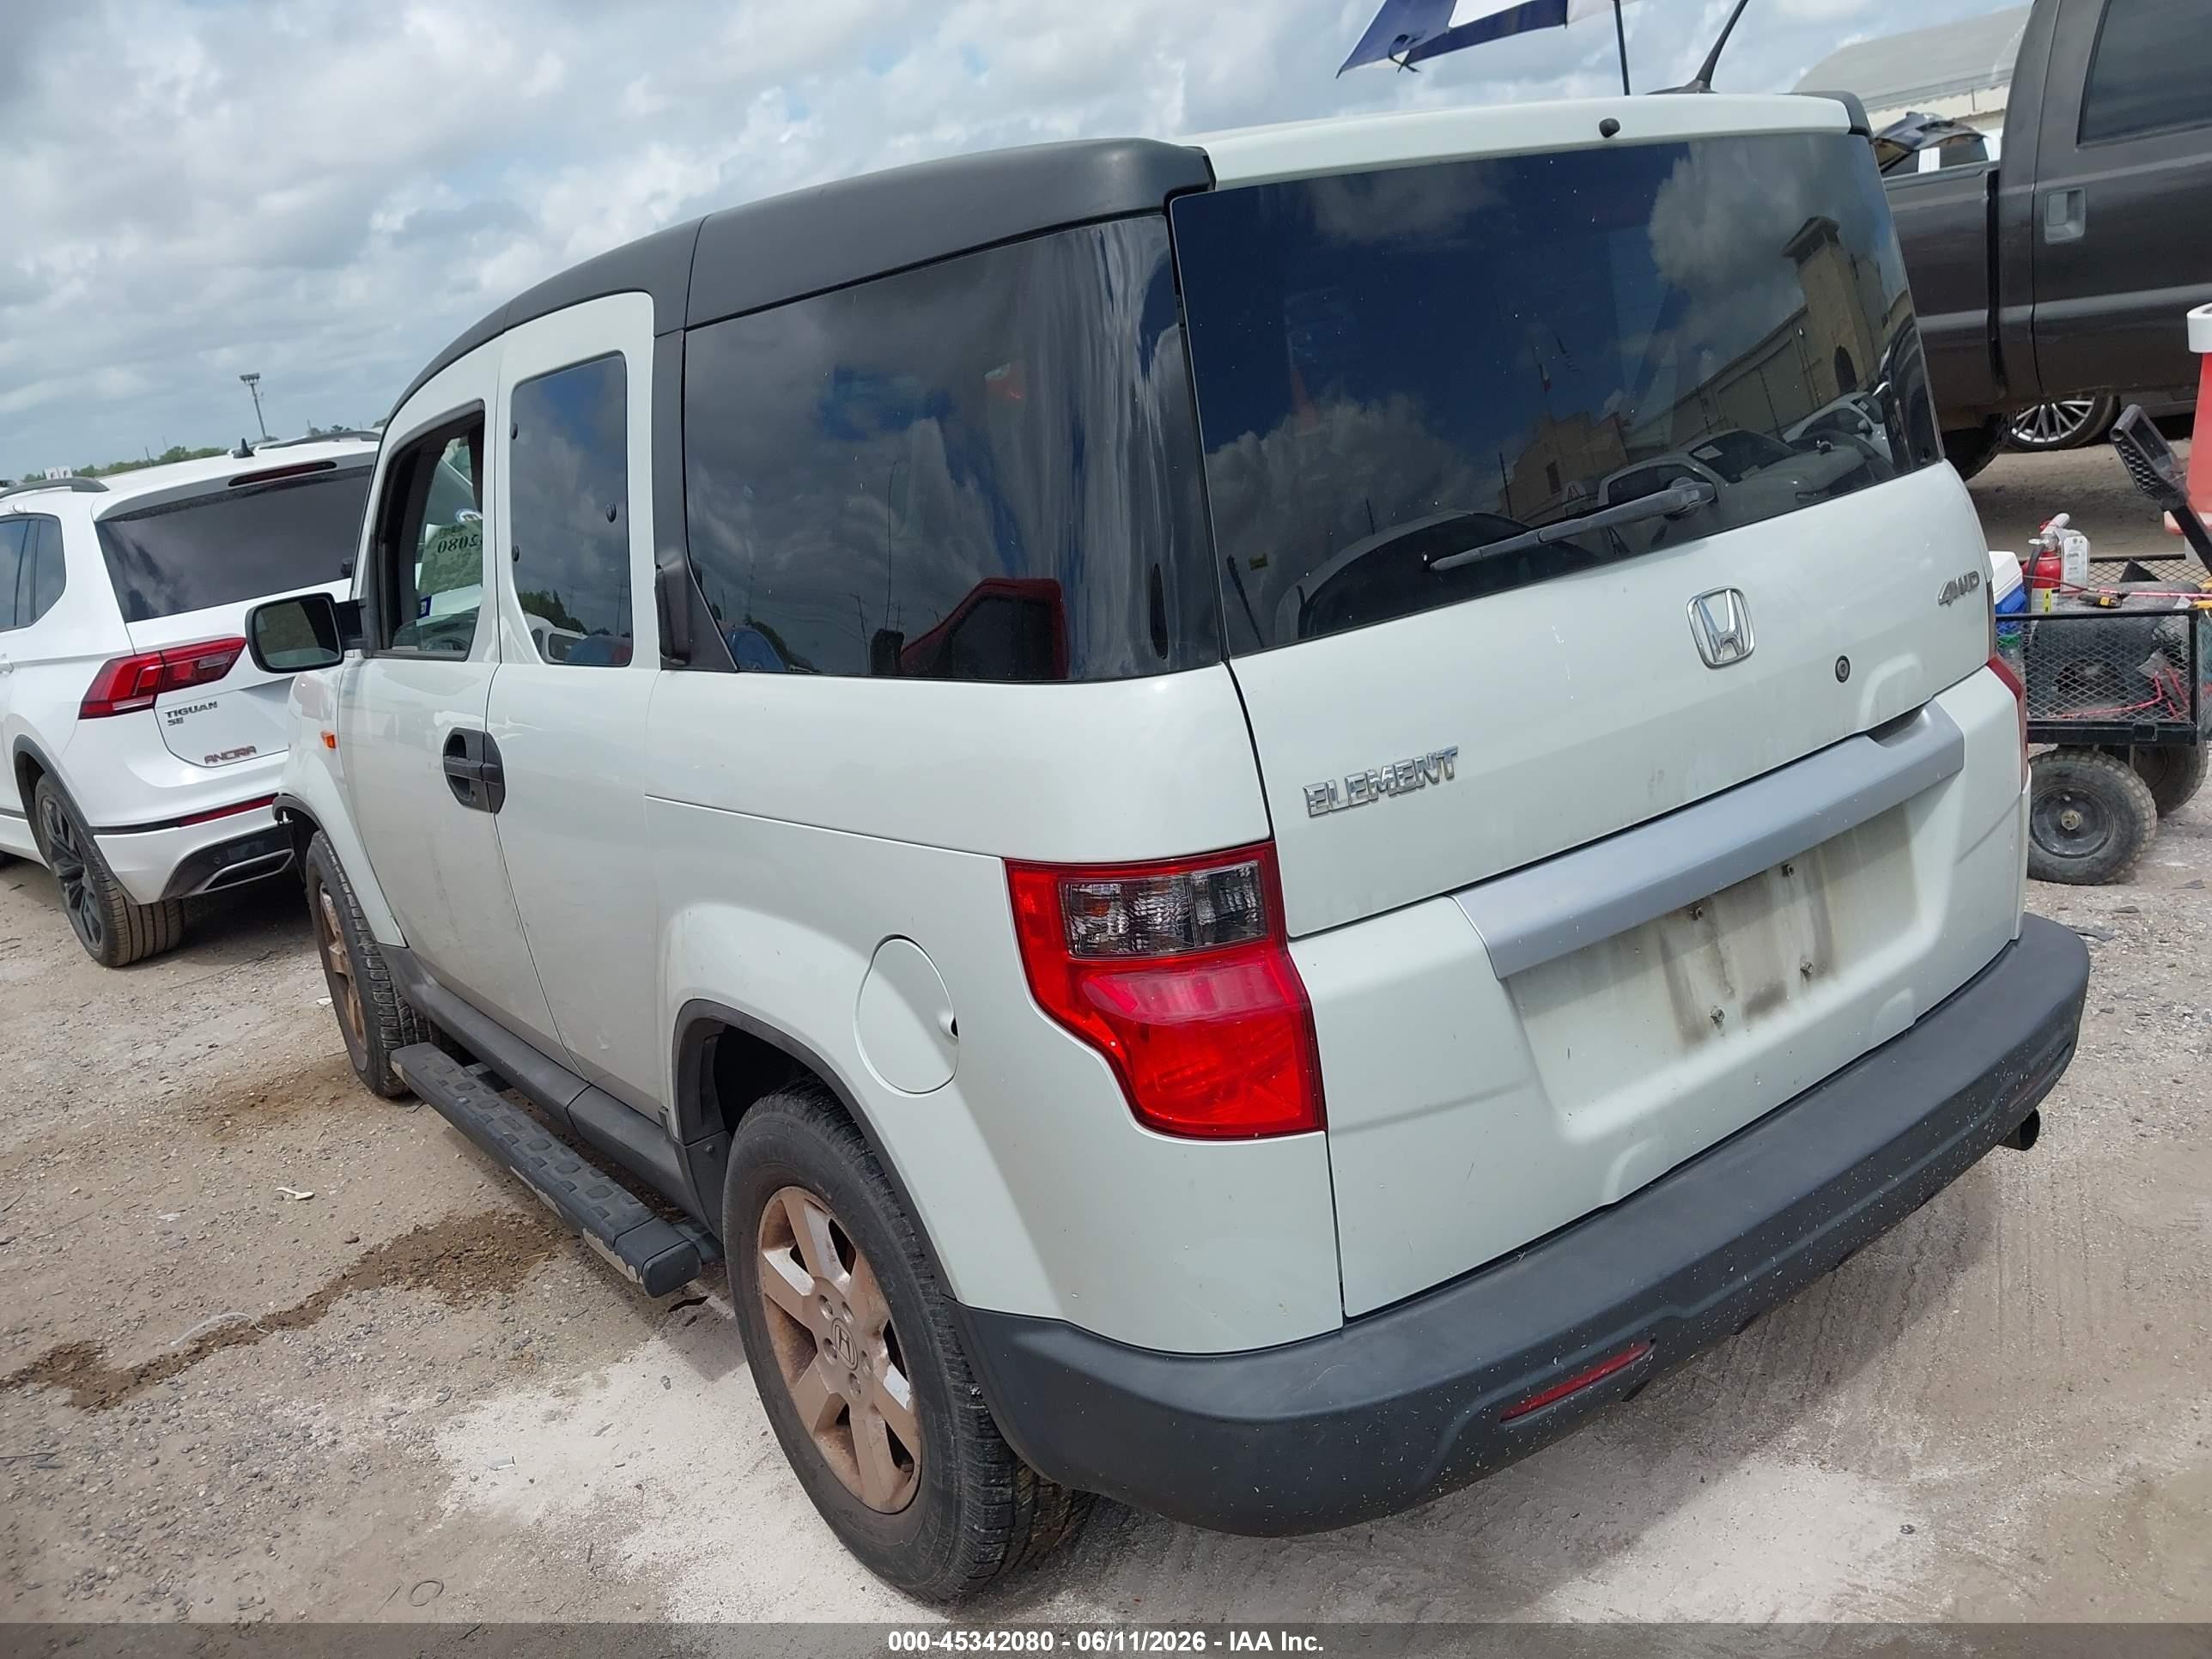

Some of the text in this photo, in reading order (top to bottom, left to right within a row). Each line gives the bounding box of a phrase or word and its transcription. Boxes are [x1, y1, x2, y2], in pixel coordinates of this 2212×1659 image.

[1937, 570, 1979, 606] 4WD
[165, 701, 217, 718] TIGUAN
[167, 716, 184, 726] SE
[1302, 745, 1459, 818] ELEMENT
